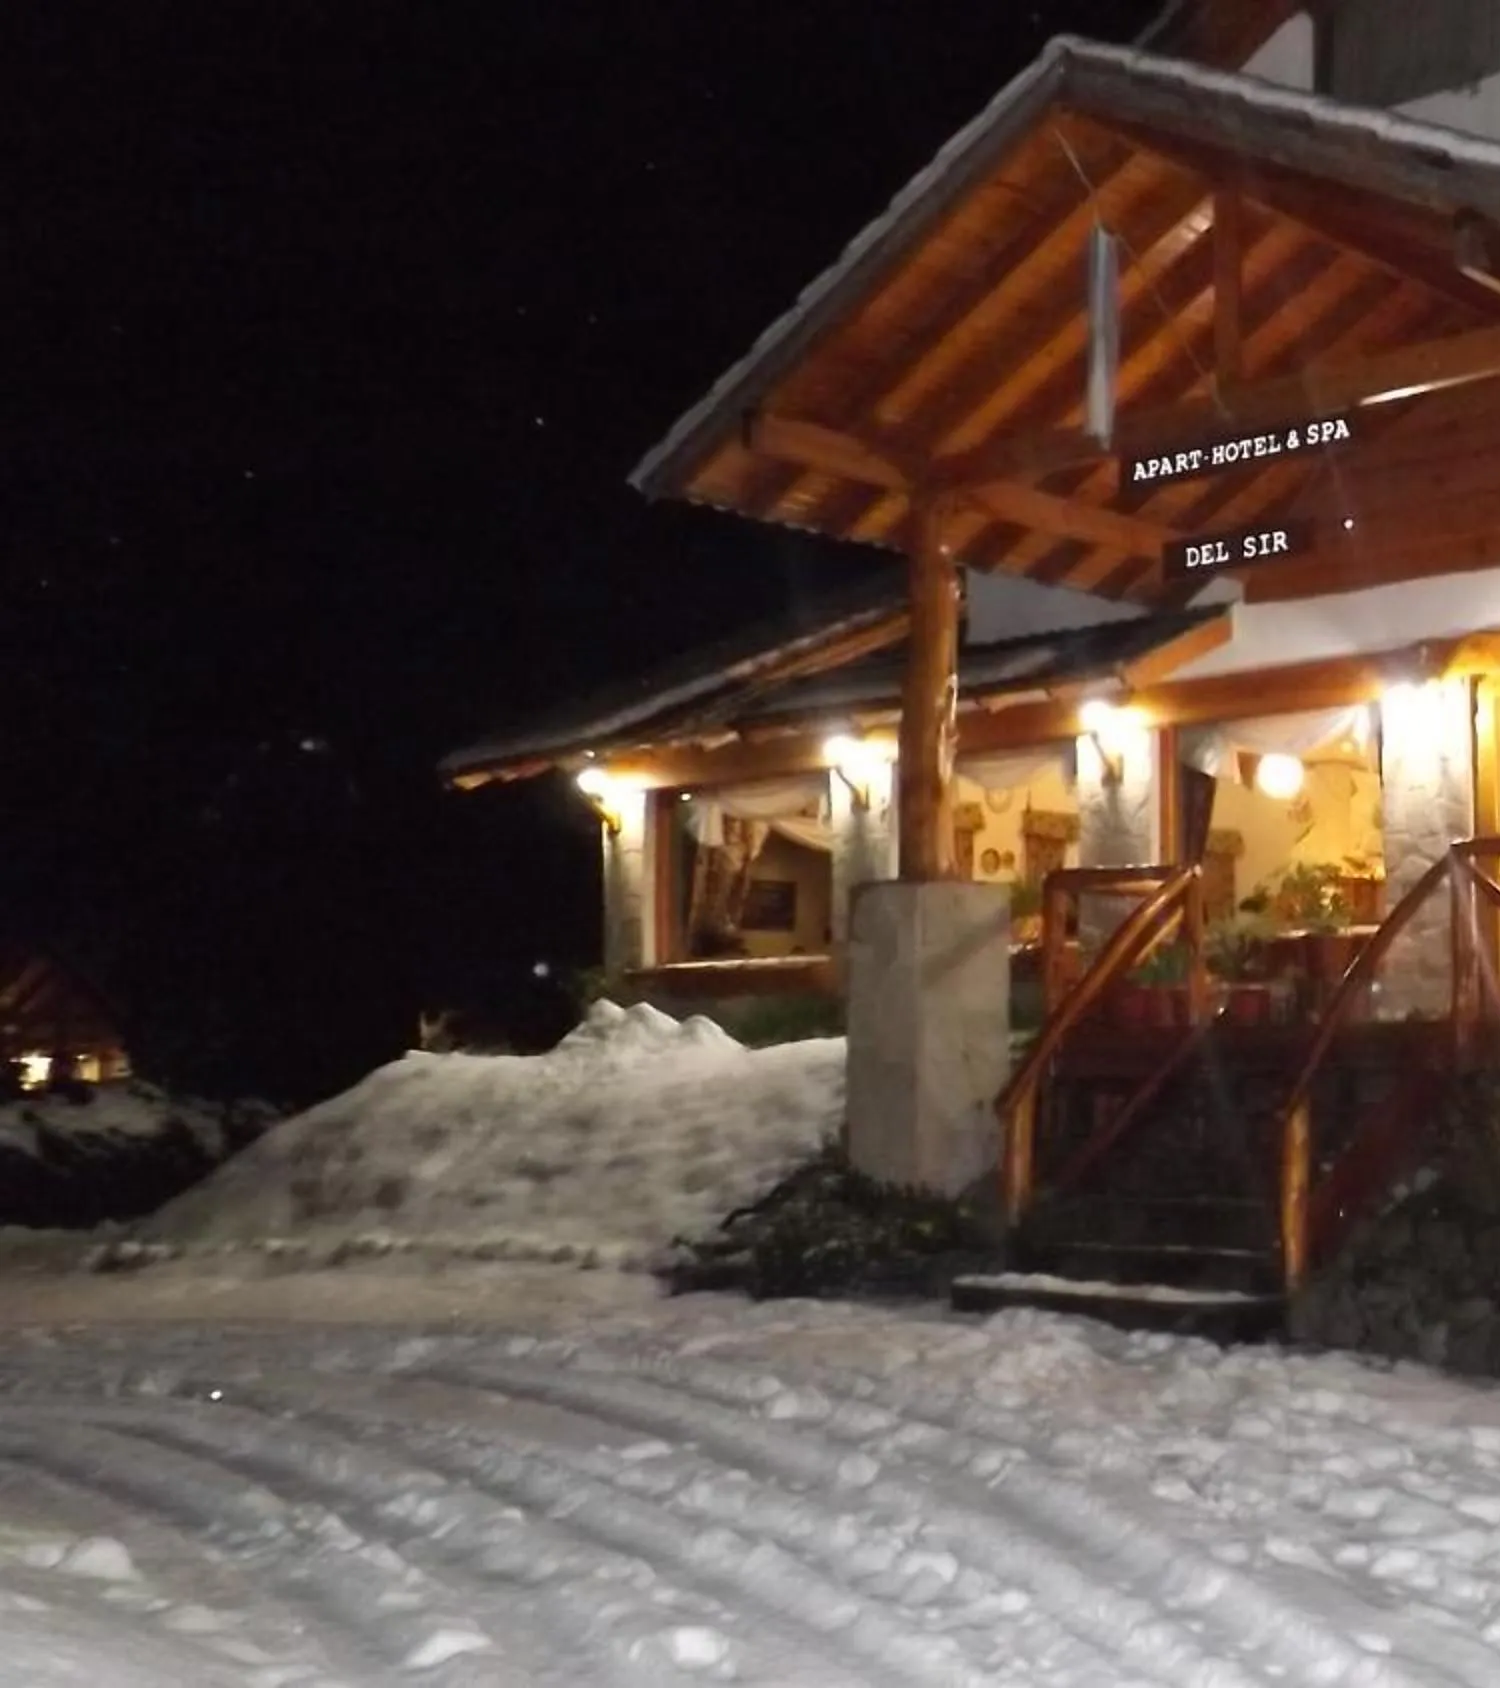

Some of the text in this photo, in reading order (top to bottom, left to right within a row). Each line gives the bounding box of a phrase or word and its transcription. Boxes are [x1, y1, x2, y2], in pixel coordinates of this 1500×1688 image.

[1287, 430, 1300, 450] &
[1306, 419, 1350, 445] SPA
[1185, 531, 1289, 568] DEL SIR
